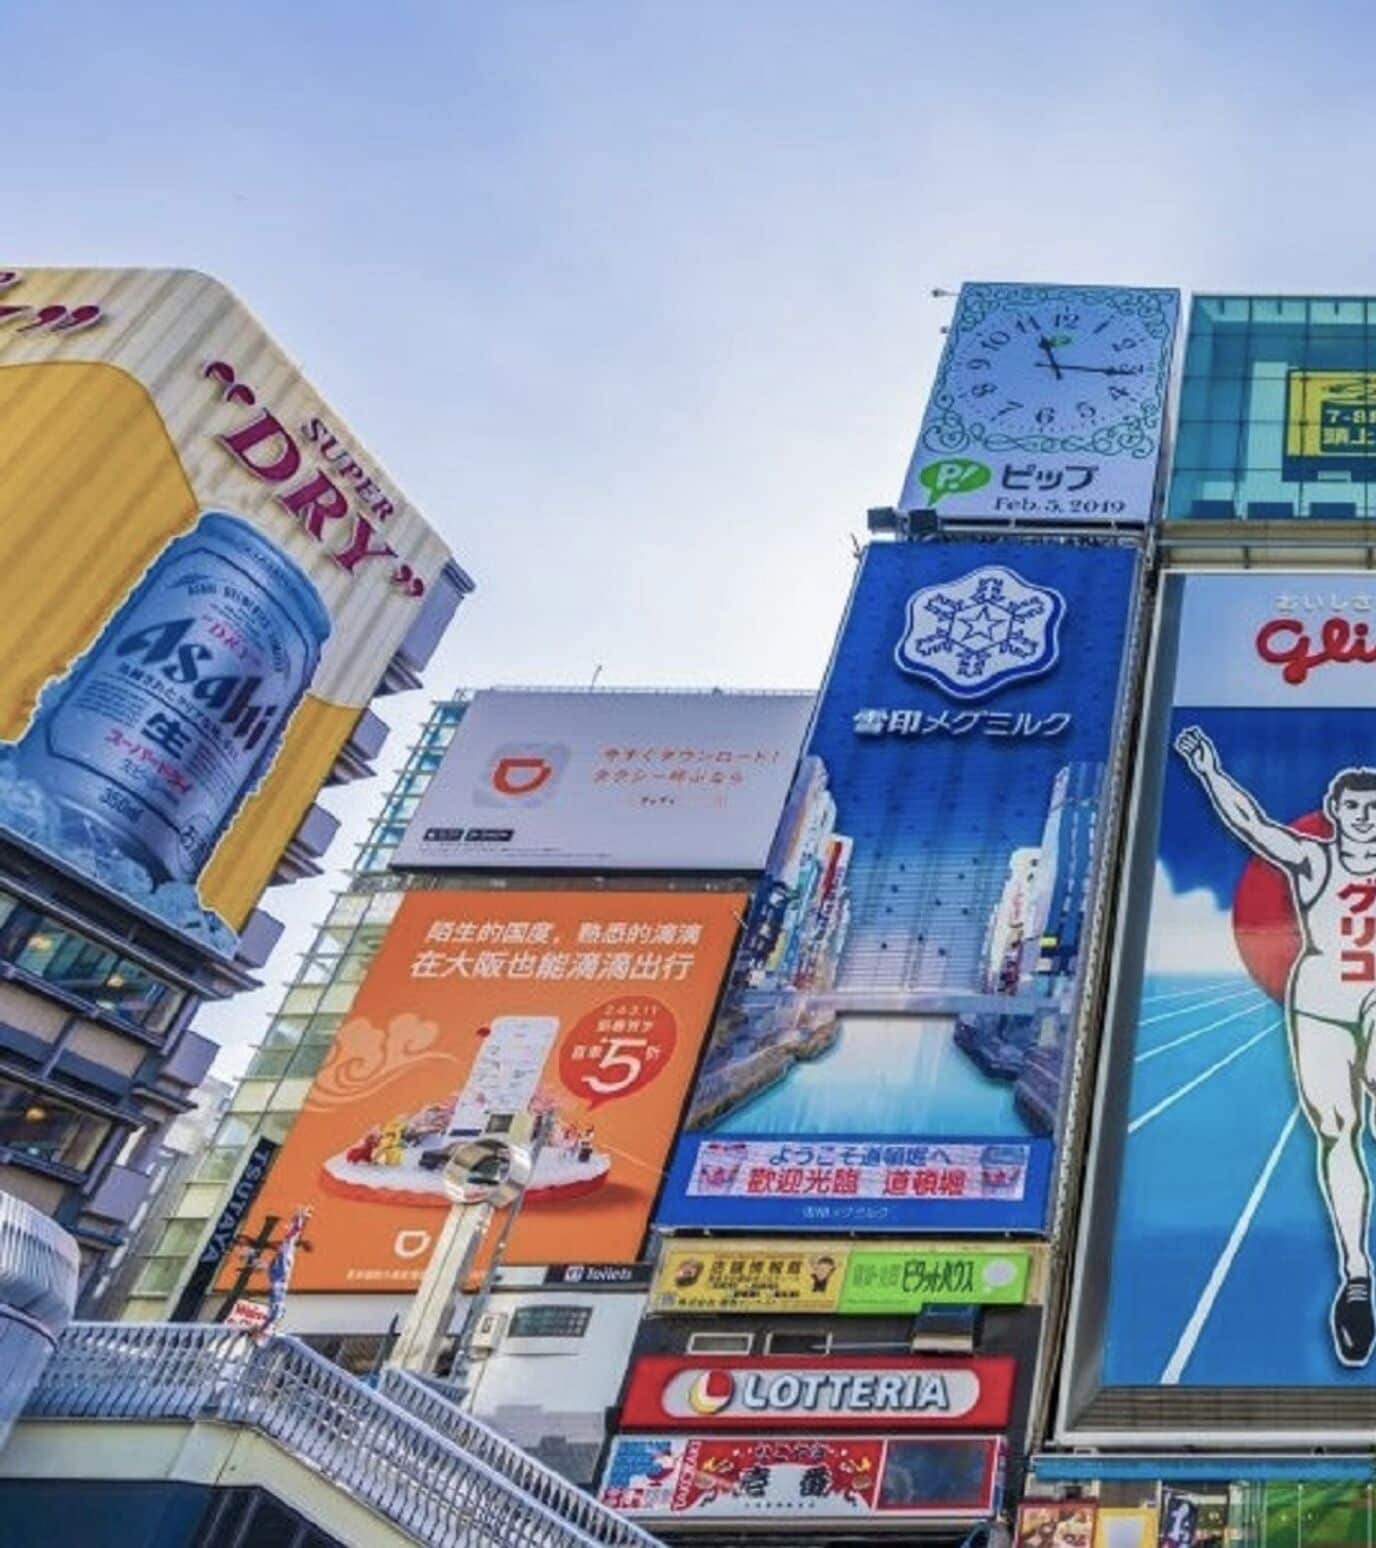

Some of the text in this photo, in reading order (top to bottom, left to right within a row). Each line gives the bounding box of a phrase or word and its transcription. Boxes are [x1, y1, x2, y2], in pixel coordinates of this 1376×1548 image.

[303, 418, 399, 523] SUPER
[1002, 463, 1099, 491] ピップ
[1070, 499, 1126, 513] 2019
[140, 712, 192, 760] 生
[853, 709, 1072, 737] 雪印メグミルク
[410, 951, 694, 980] 在大阪也能滴滴出行
[769, 1146, 950, 1166] ようこそ道頓堀へ
[201, 1152, 268, 1262] TSUTAYA
[586, 1267, 632, 1281] Toilets
[743, 1375, 951, 1411] LOTTERIA
